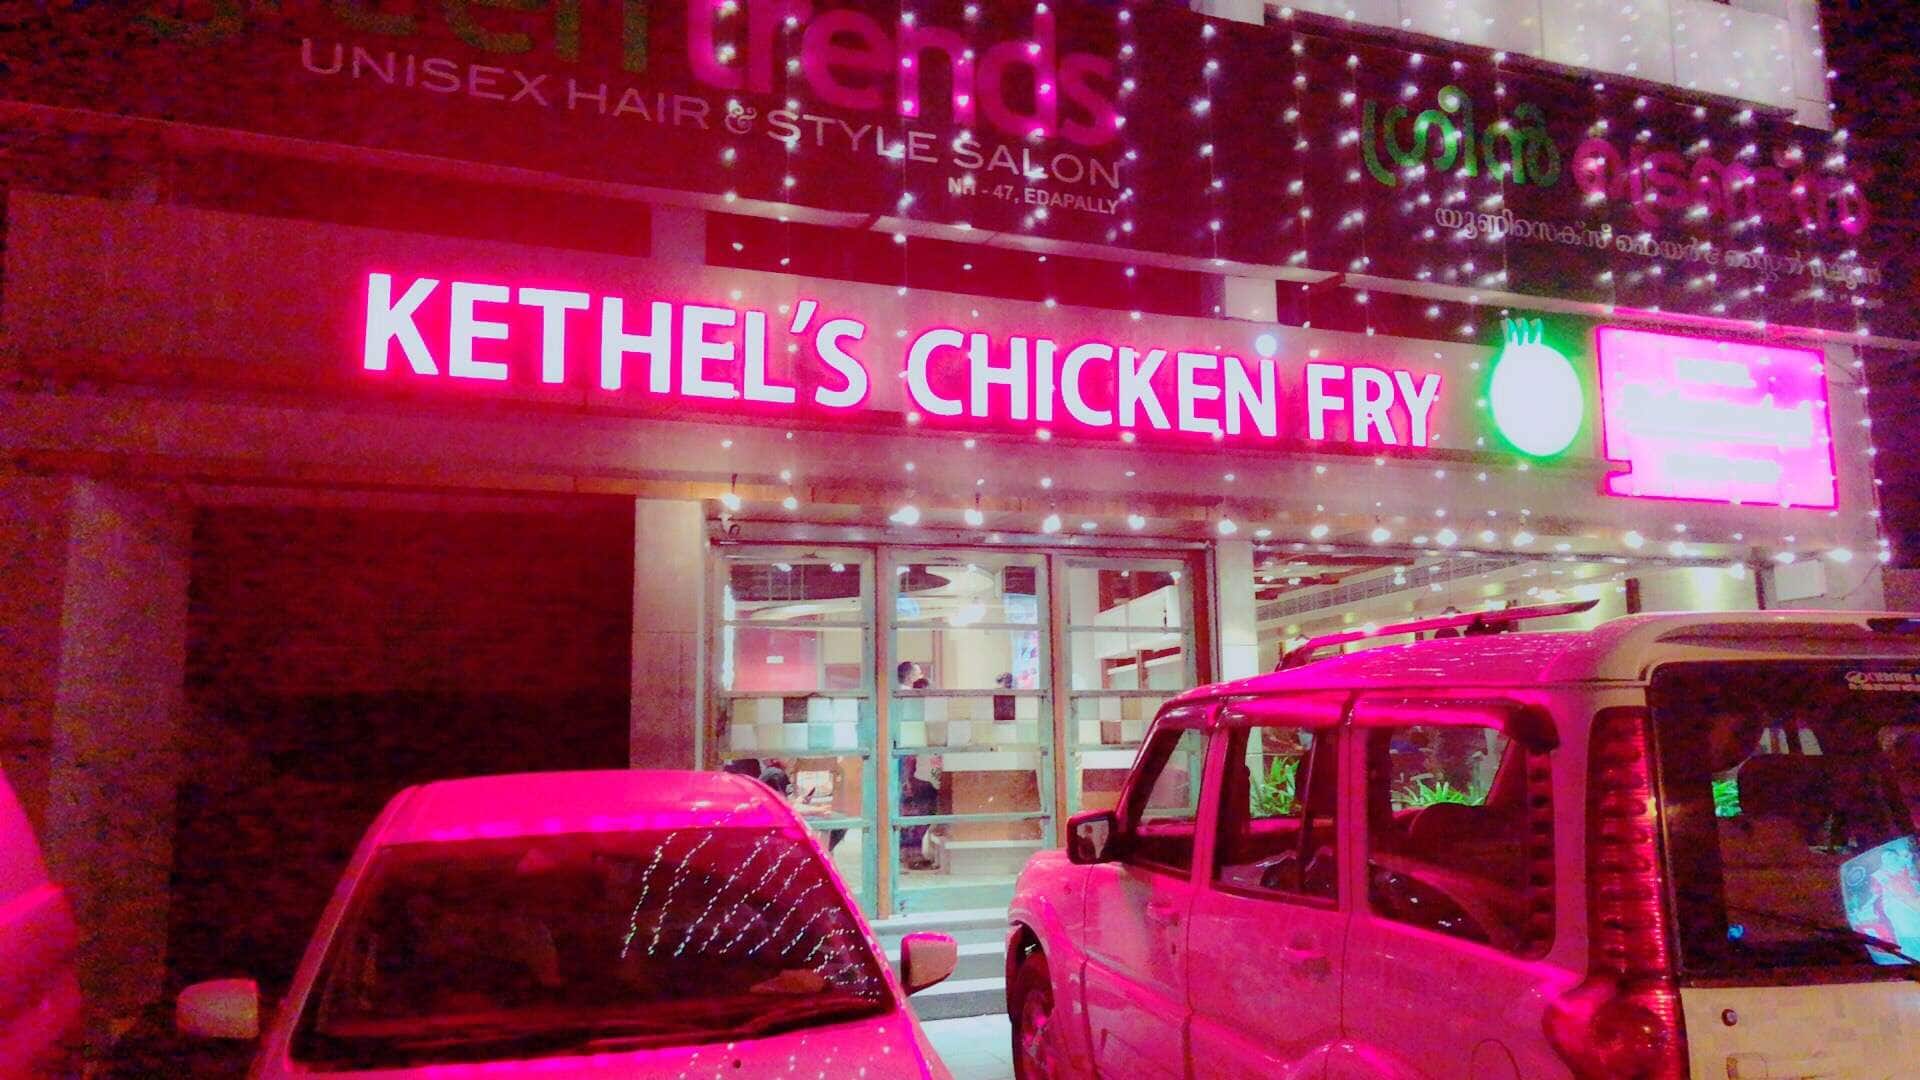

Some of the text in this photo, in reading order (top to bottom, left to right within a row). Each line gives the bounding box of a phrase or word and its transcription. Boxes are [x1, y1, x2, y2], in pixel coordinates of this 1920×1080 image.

[301, 38, 1119, 190] UNISEX HAIR & STYLE SALON
[1024, 187, 1119, 215] EDAPALLY
[364, 272, 1442, 447] KETHEL'S CHICKEN FRY
